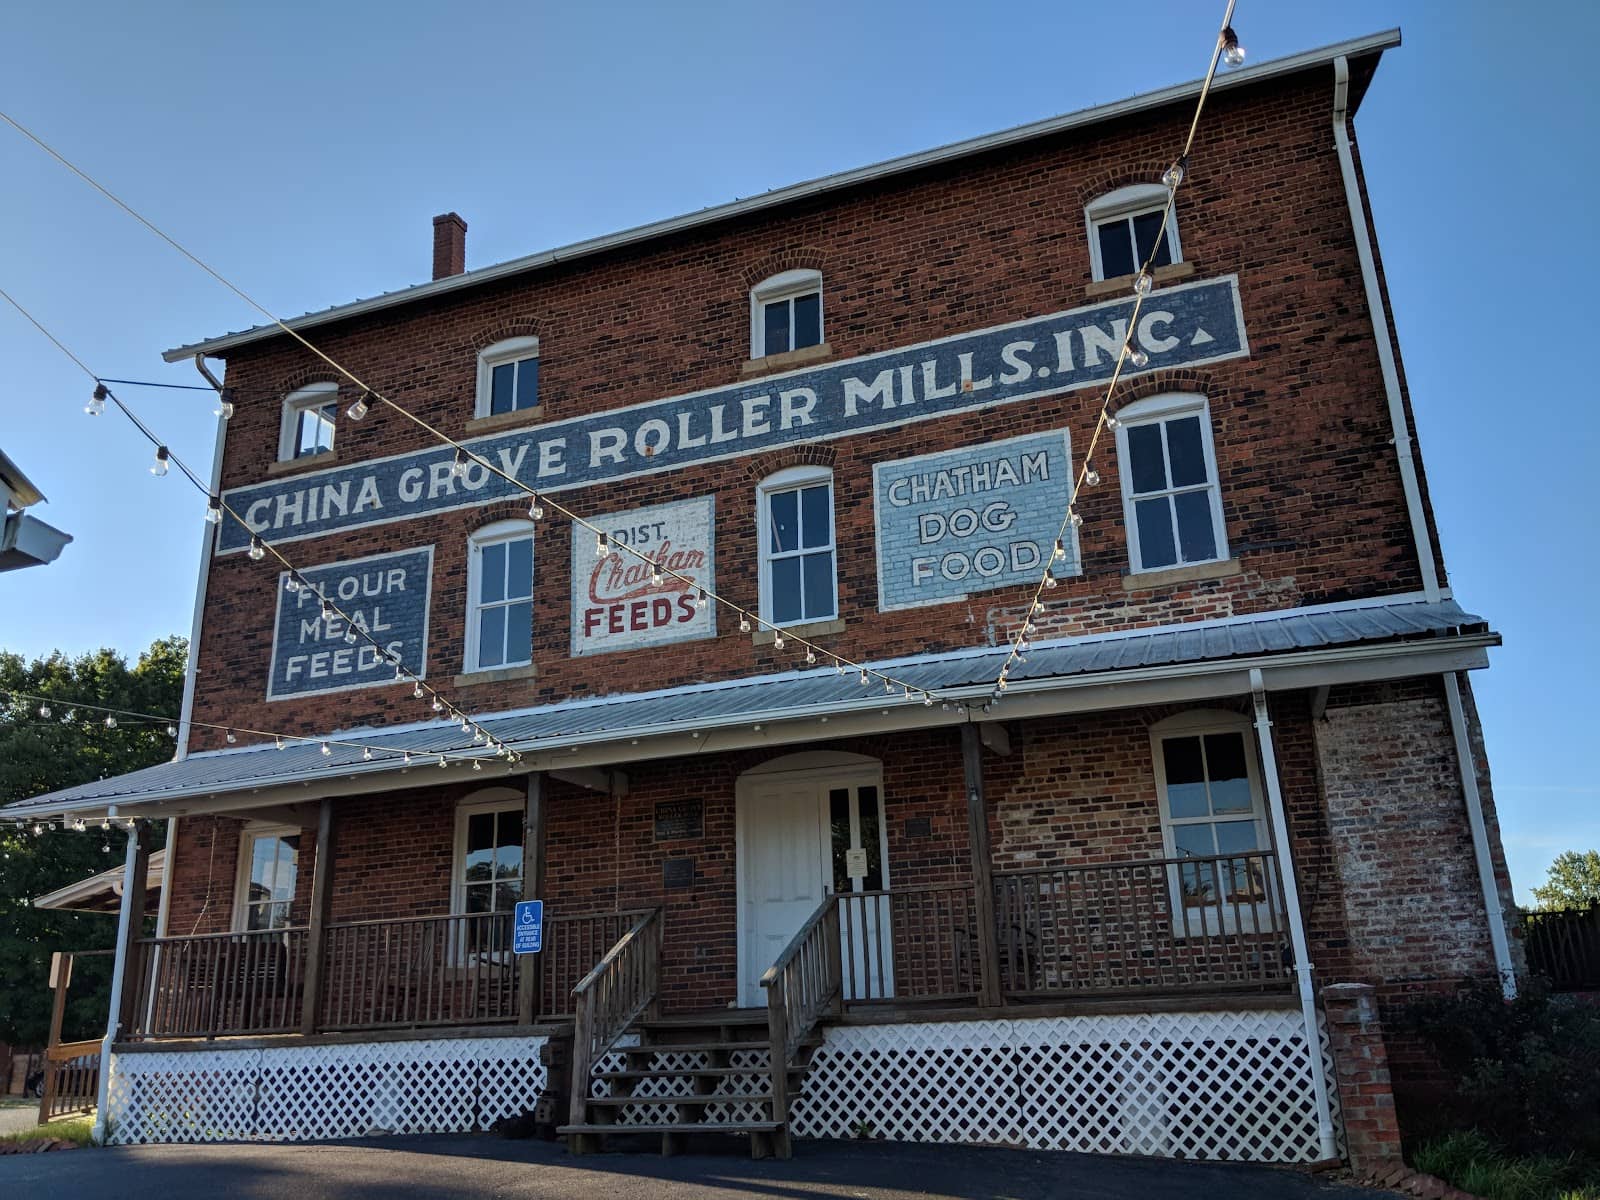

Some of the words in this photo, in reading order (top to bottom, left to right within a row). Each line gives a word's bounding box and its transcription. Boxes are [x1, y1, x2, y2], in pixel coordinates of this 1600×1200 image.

[245, 474, 382, 534] CHINA
[398, 437, 567, 503] GROVE
[588, 387, 817, 468] ROLLER
[887, 451, 1050, 508] CHATHAM
[611, 521, 668, 549] DIST.
[918, 501, 1017, 545] DOG
[589, 540, 705, 605] Chatham
[911, 540, 1042, 587] FOOD
[297, 568, 407, 609] FLOUR
[299, 606, 392, 644] MEAL
[584, 594, 696, 638] FEEDS
[285, 641, 404, 682] FEEDS
